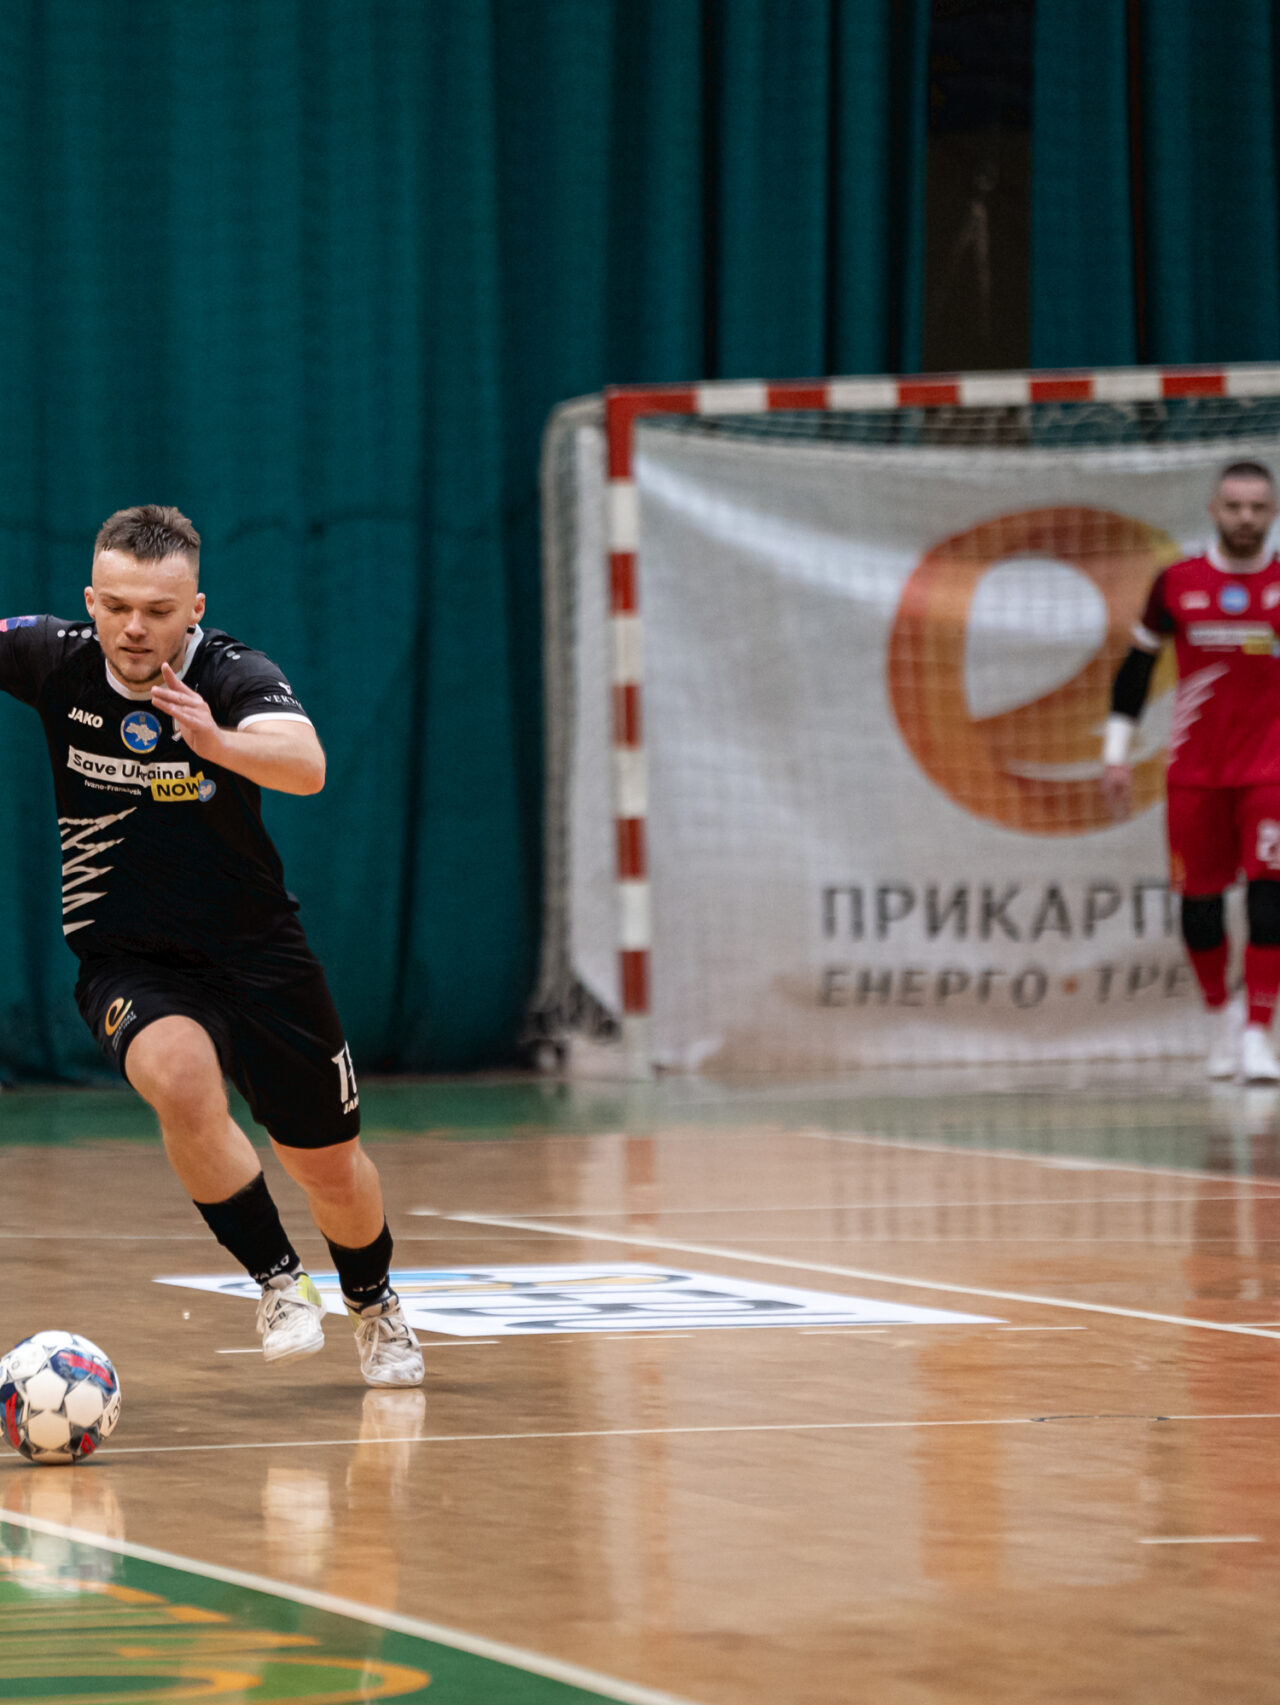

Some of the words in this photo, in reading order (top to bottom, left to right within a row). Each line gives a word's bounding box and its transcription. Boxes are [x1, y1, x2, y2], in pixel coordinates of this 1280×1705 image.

[67, 707, 104, 729] JAKO
[73, 753, 117, 776] Save
[122, 763, 185, 782] Ukraine
[156, 779, 200, 797] NOW
[823, 877, 1174, 942] ПРИКАРП
[821, 963, 1050, 1009] ЕНЕРГО
